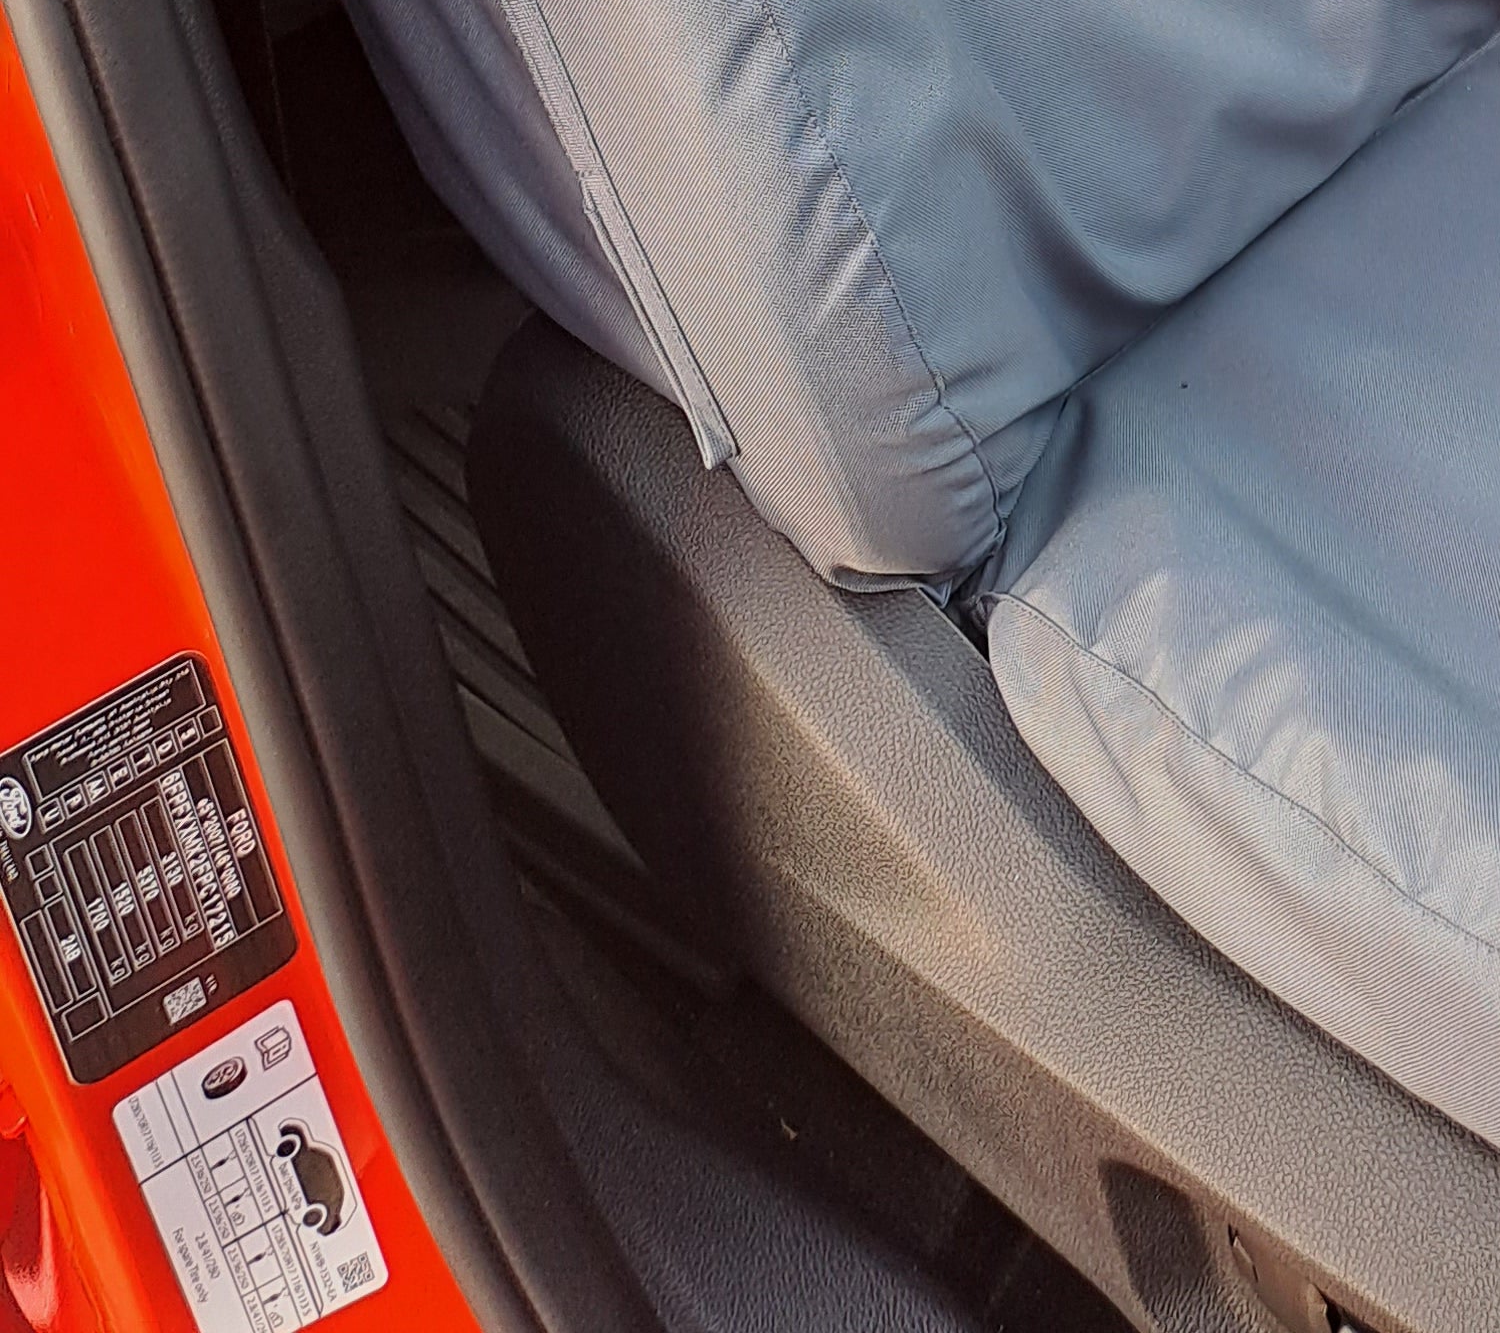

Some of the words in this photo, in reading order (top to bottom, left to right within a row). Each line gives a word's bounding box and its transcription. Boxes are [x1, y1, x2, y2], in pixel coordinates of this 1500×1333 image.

[154, 740, 174, 754] D
[132, 752, 152, 767] T
[108, 766, 127, 781] E
[85, 778, 105, 797] M
[0, 786, 27, 830] Ford
[63, 793, 83, 808] P
[225, 808, 256, 860] FORD
[160, 850, 184, 888] 3130
[182, 911, 201, 937] kg
[111, 881, 134, 917] 1520
[133, 942, 149, 968] kg
[86, 896, 109, 932] 1700
[109, 957, 125, 982] kg
[158, 925, 176, 953] kg
[172, 1226, 185, 1245] For
[174, 1242, 194, 1268] spare
[193, 1281, 209, 1304] only
